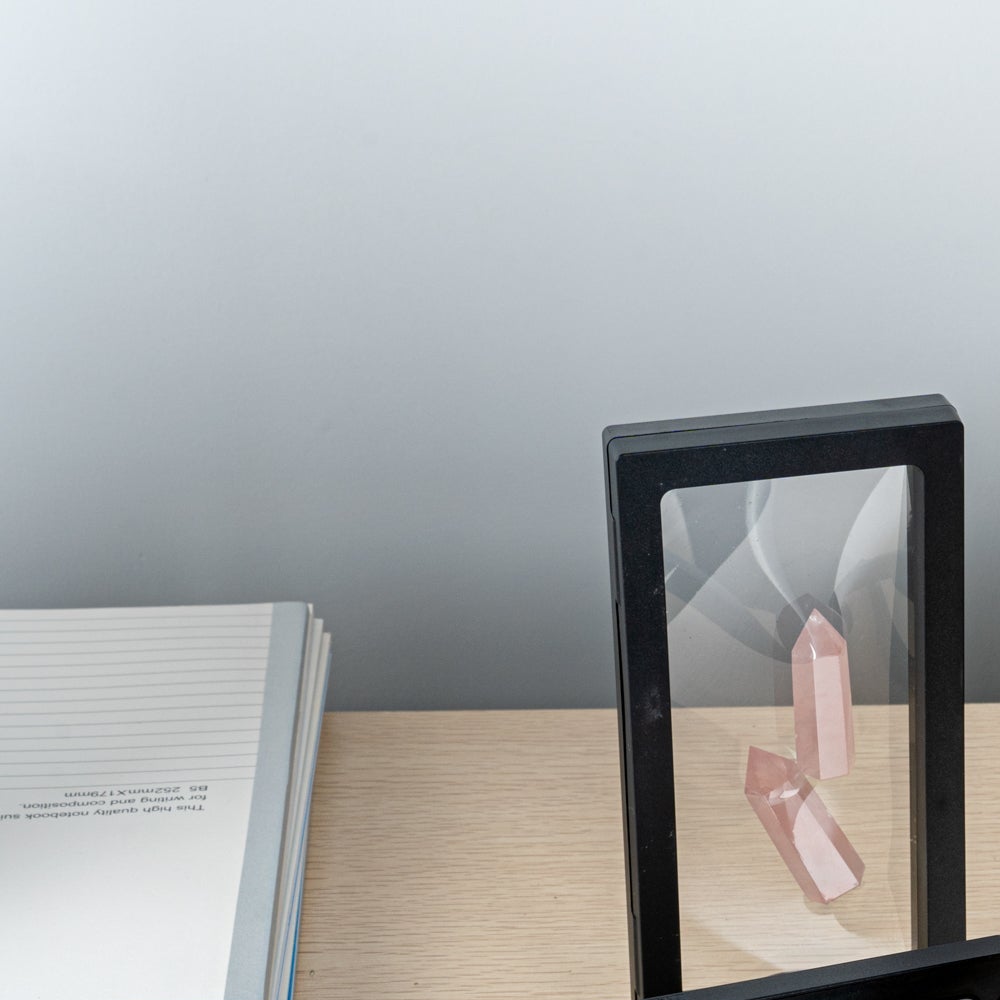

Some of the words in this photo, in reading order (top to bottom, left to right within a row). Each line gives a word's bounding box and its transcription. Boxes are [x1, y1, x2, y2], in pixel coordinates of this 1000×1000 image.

[19, 800, 106, 809] composition.
[25, 810, 89, 820] notebook
[94, 807, 139, 816] quality
